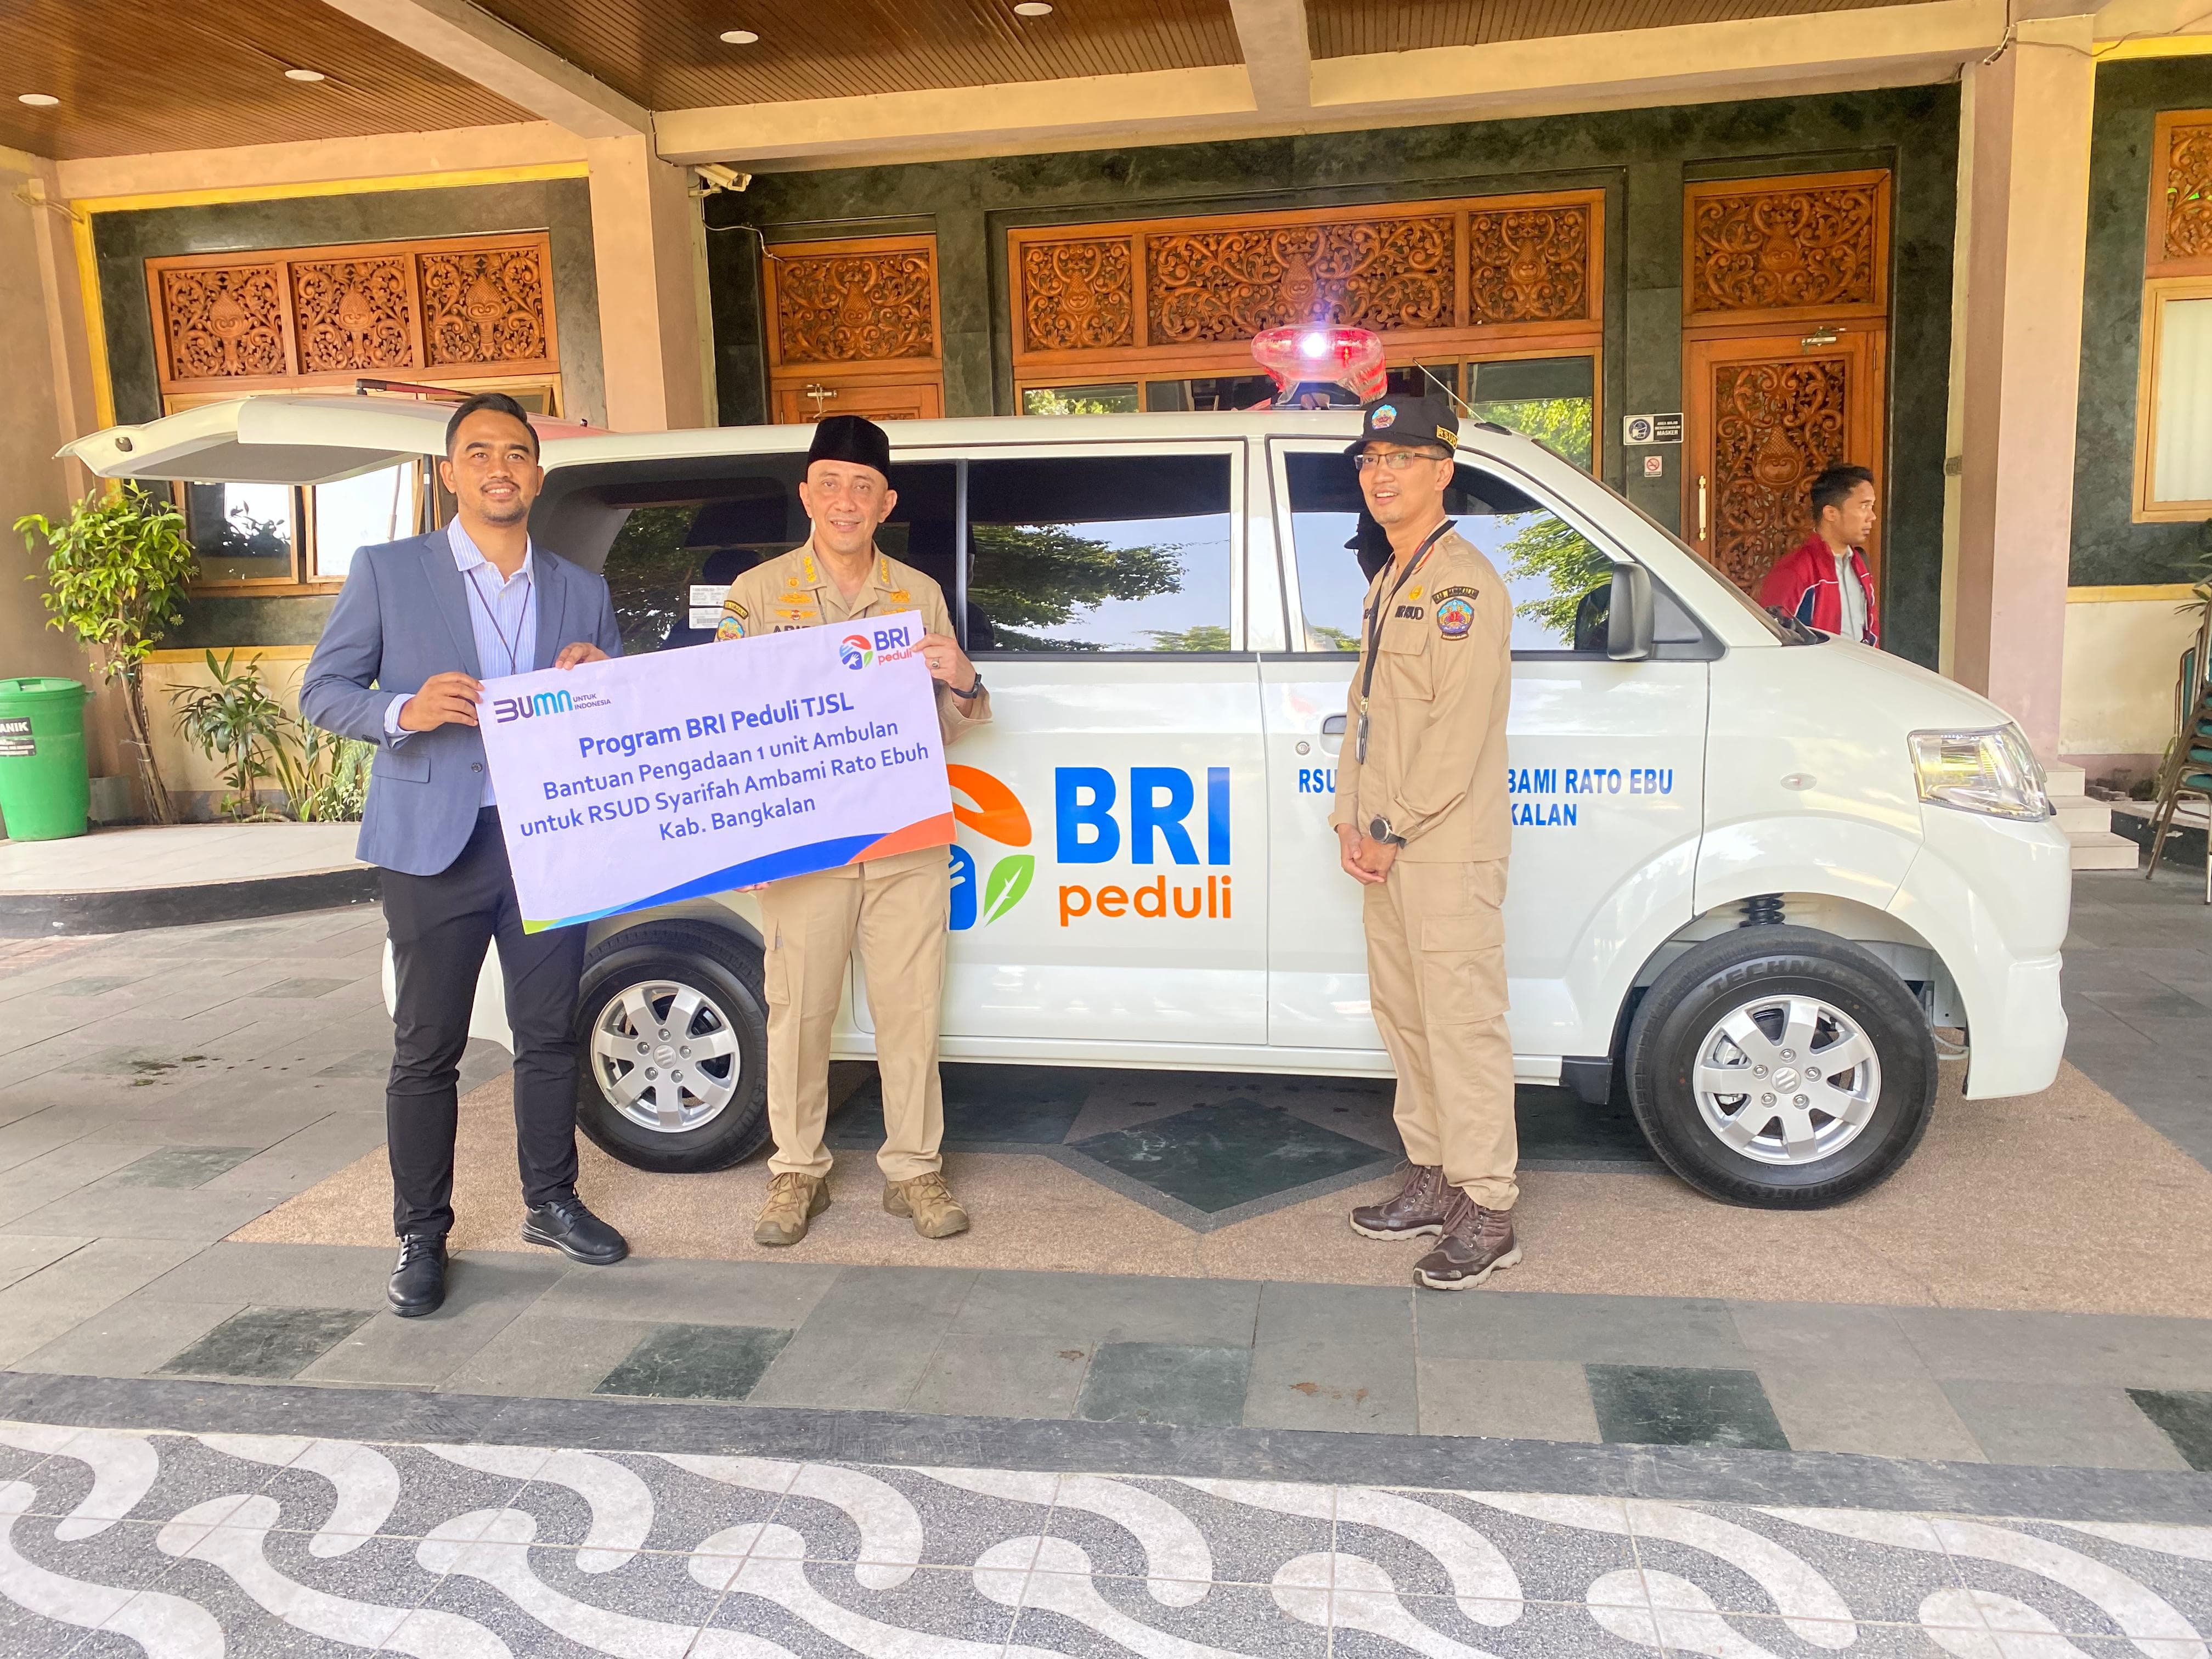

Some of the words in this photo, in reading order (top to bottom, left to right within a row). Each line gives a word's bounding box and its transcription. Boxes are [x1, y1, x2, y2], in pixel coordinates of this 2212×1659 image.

[1438, 428, 1457, 444] RSUD
[874, 627, 910, 651] BRI
[878, 648, 912, 665] peduli
[573, 693, 597, 702] UNTUK
[574, 699, 611, 710] INDONESIA
[579, 725, 681, 758] Program
[686, 713, 726, 739] BRI
[731, 699, 799, 731] Peduli
[801, 692, 854, 718] TJSL
[543, 770, 634, 800] Bantuan
[638, 751, 753, 782] Pengadaan
[757, 746, 765, 760] 1
[770, 735, 809, 758] unit
[813, 721, 899, 750] Ambulan
[520, 808, 584, 837] untuk
[588, 796, 651, 823] RSUD
[654, 778, 740, 813] Syarifah
[744, 761, 826, 793] Ambami
[831, 755, 877, 776] Rato
[881, 742, 929, 766] Ebuh
[1299, 769, 1337, 793] RSU
[1508, 769, 1557, 793] BAMI
[1565, 769, 1622, 794] RATO
[1629, 769, 1673, 794] EBU
[659, 817, 707, 841] Kab.
[711, 798, 816, 830] Bangkalan
[1055, 767, 1231, 865] BRI
[1059, 874, 1232, 927] peduli
